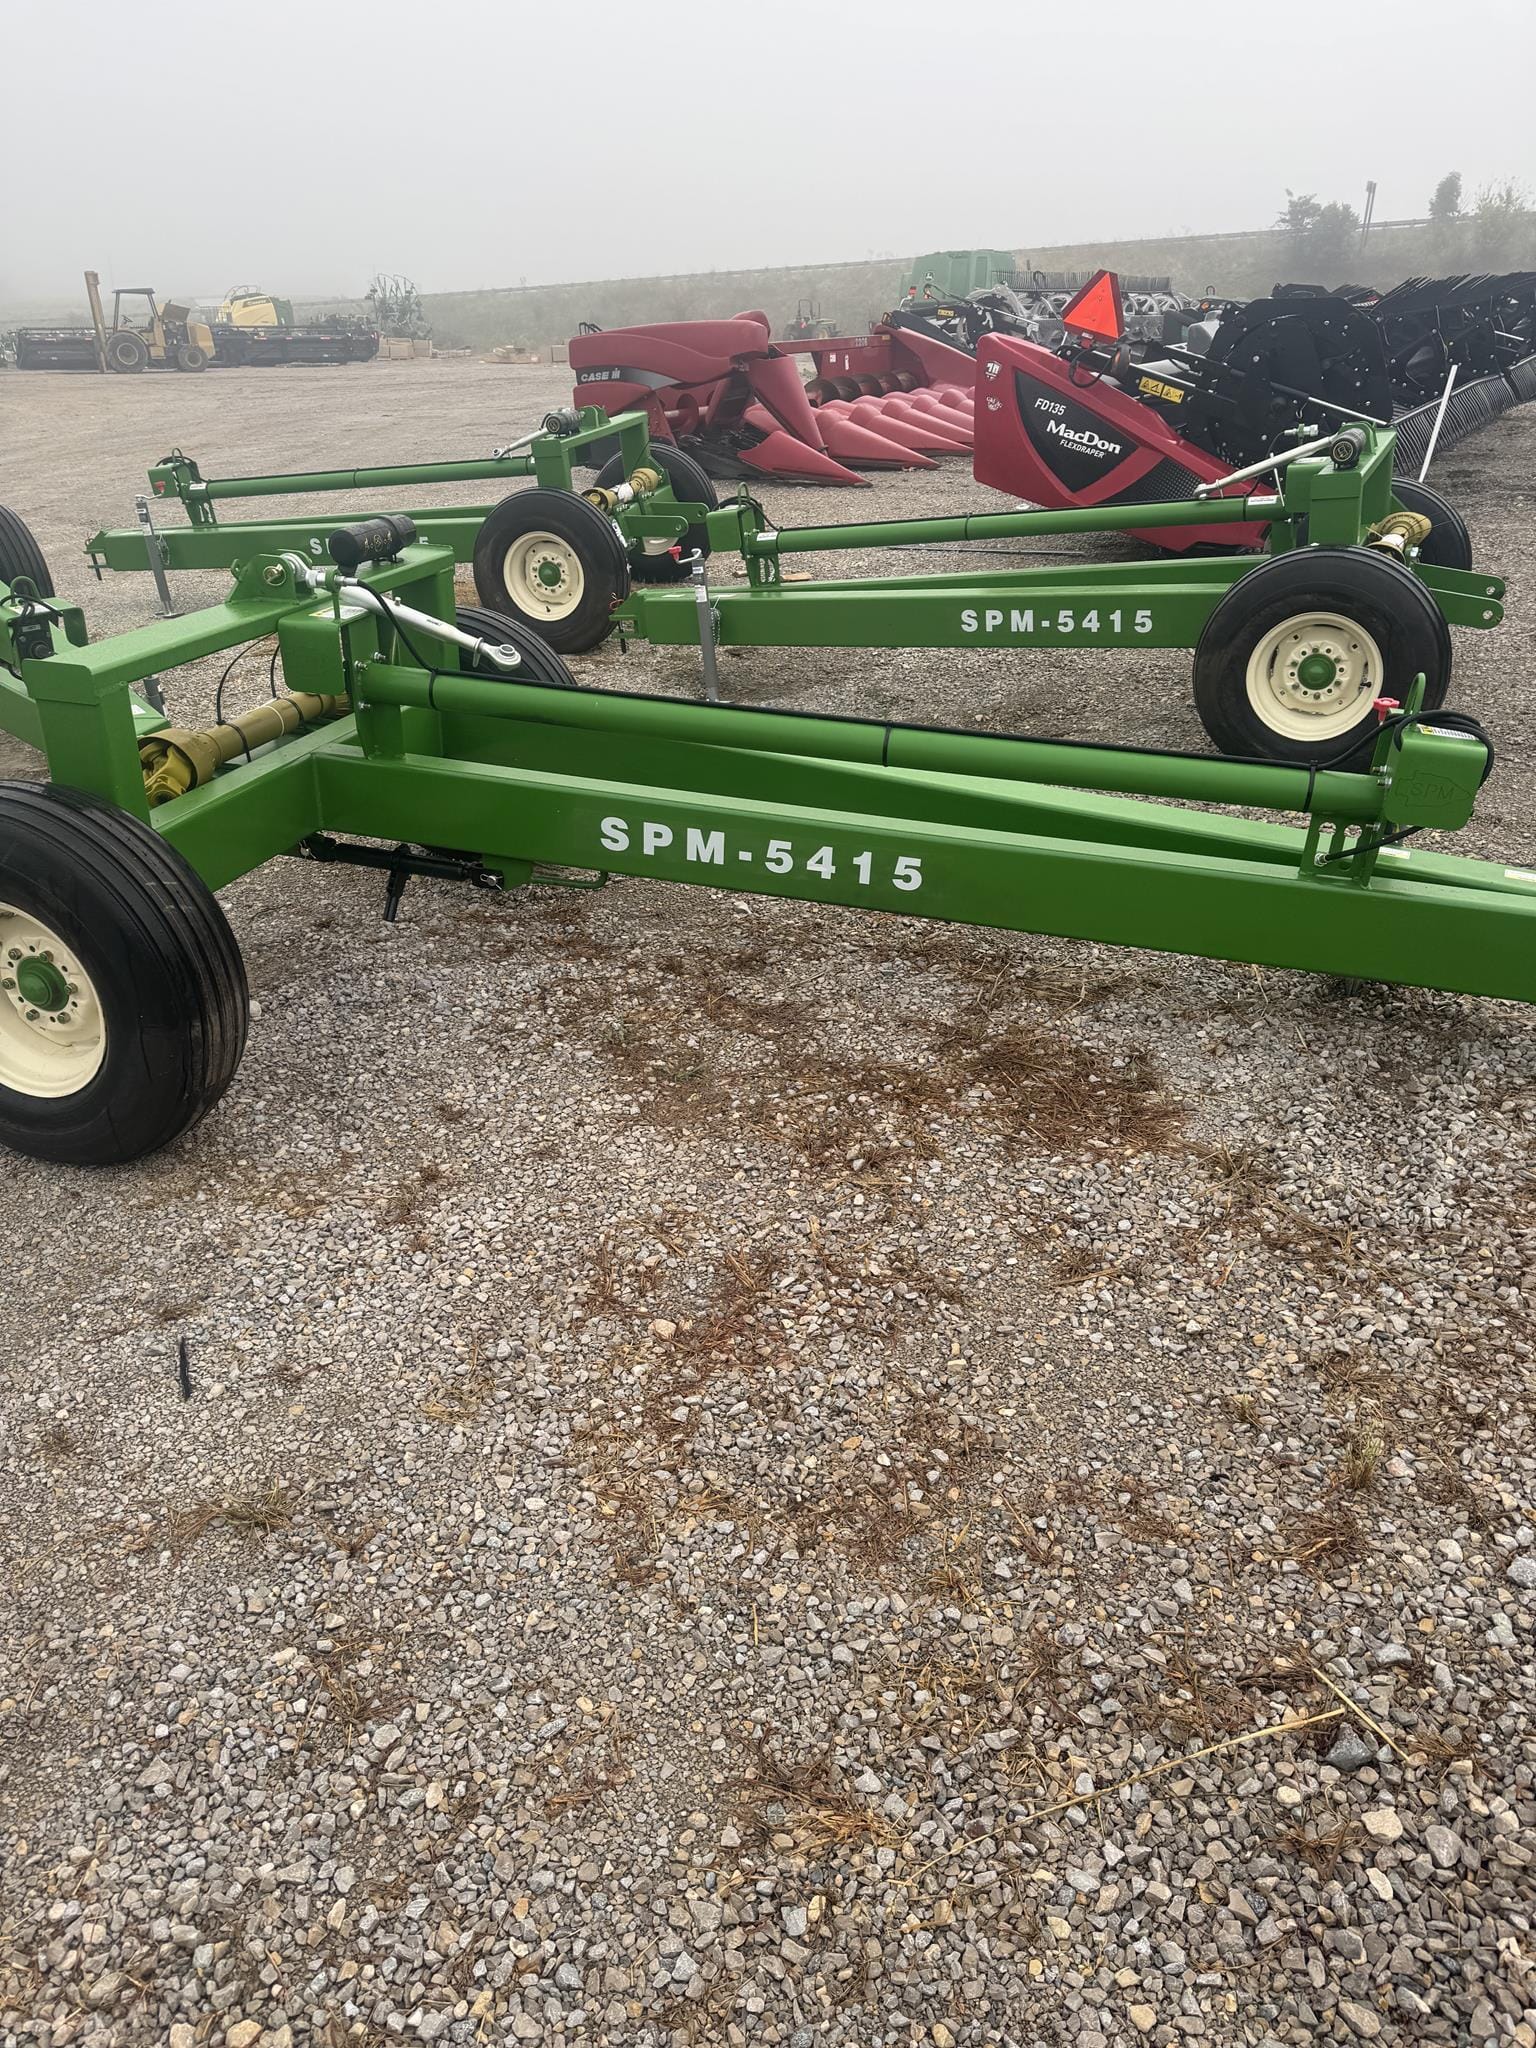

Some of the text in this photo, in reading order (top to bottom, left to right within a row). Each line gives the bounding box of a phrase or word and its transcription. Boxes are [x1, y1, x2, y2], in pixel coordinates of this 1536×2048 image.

[580, 371, 609, 382] CASE
[1034, 398, 1066, 416] FD135
[1046, 419, 1121, 455] MacDon
[1060, 439, 1106, 459] FLEXDRAPER
[960, 609, 1153, 633] SPM-5415
[1410, 782, 1456, 801] SPM
[600, 816, 923, 891] SPM-5415
